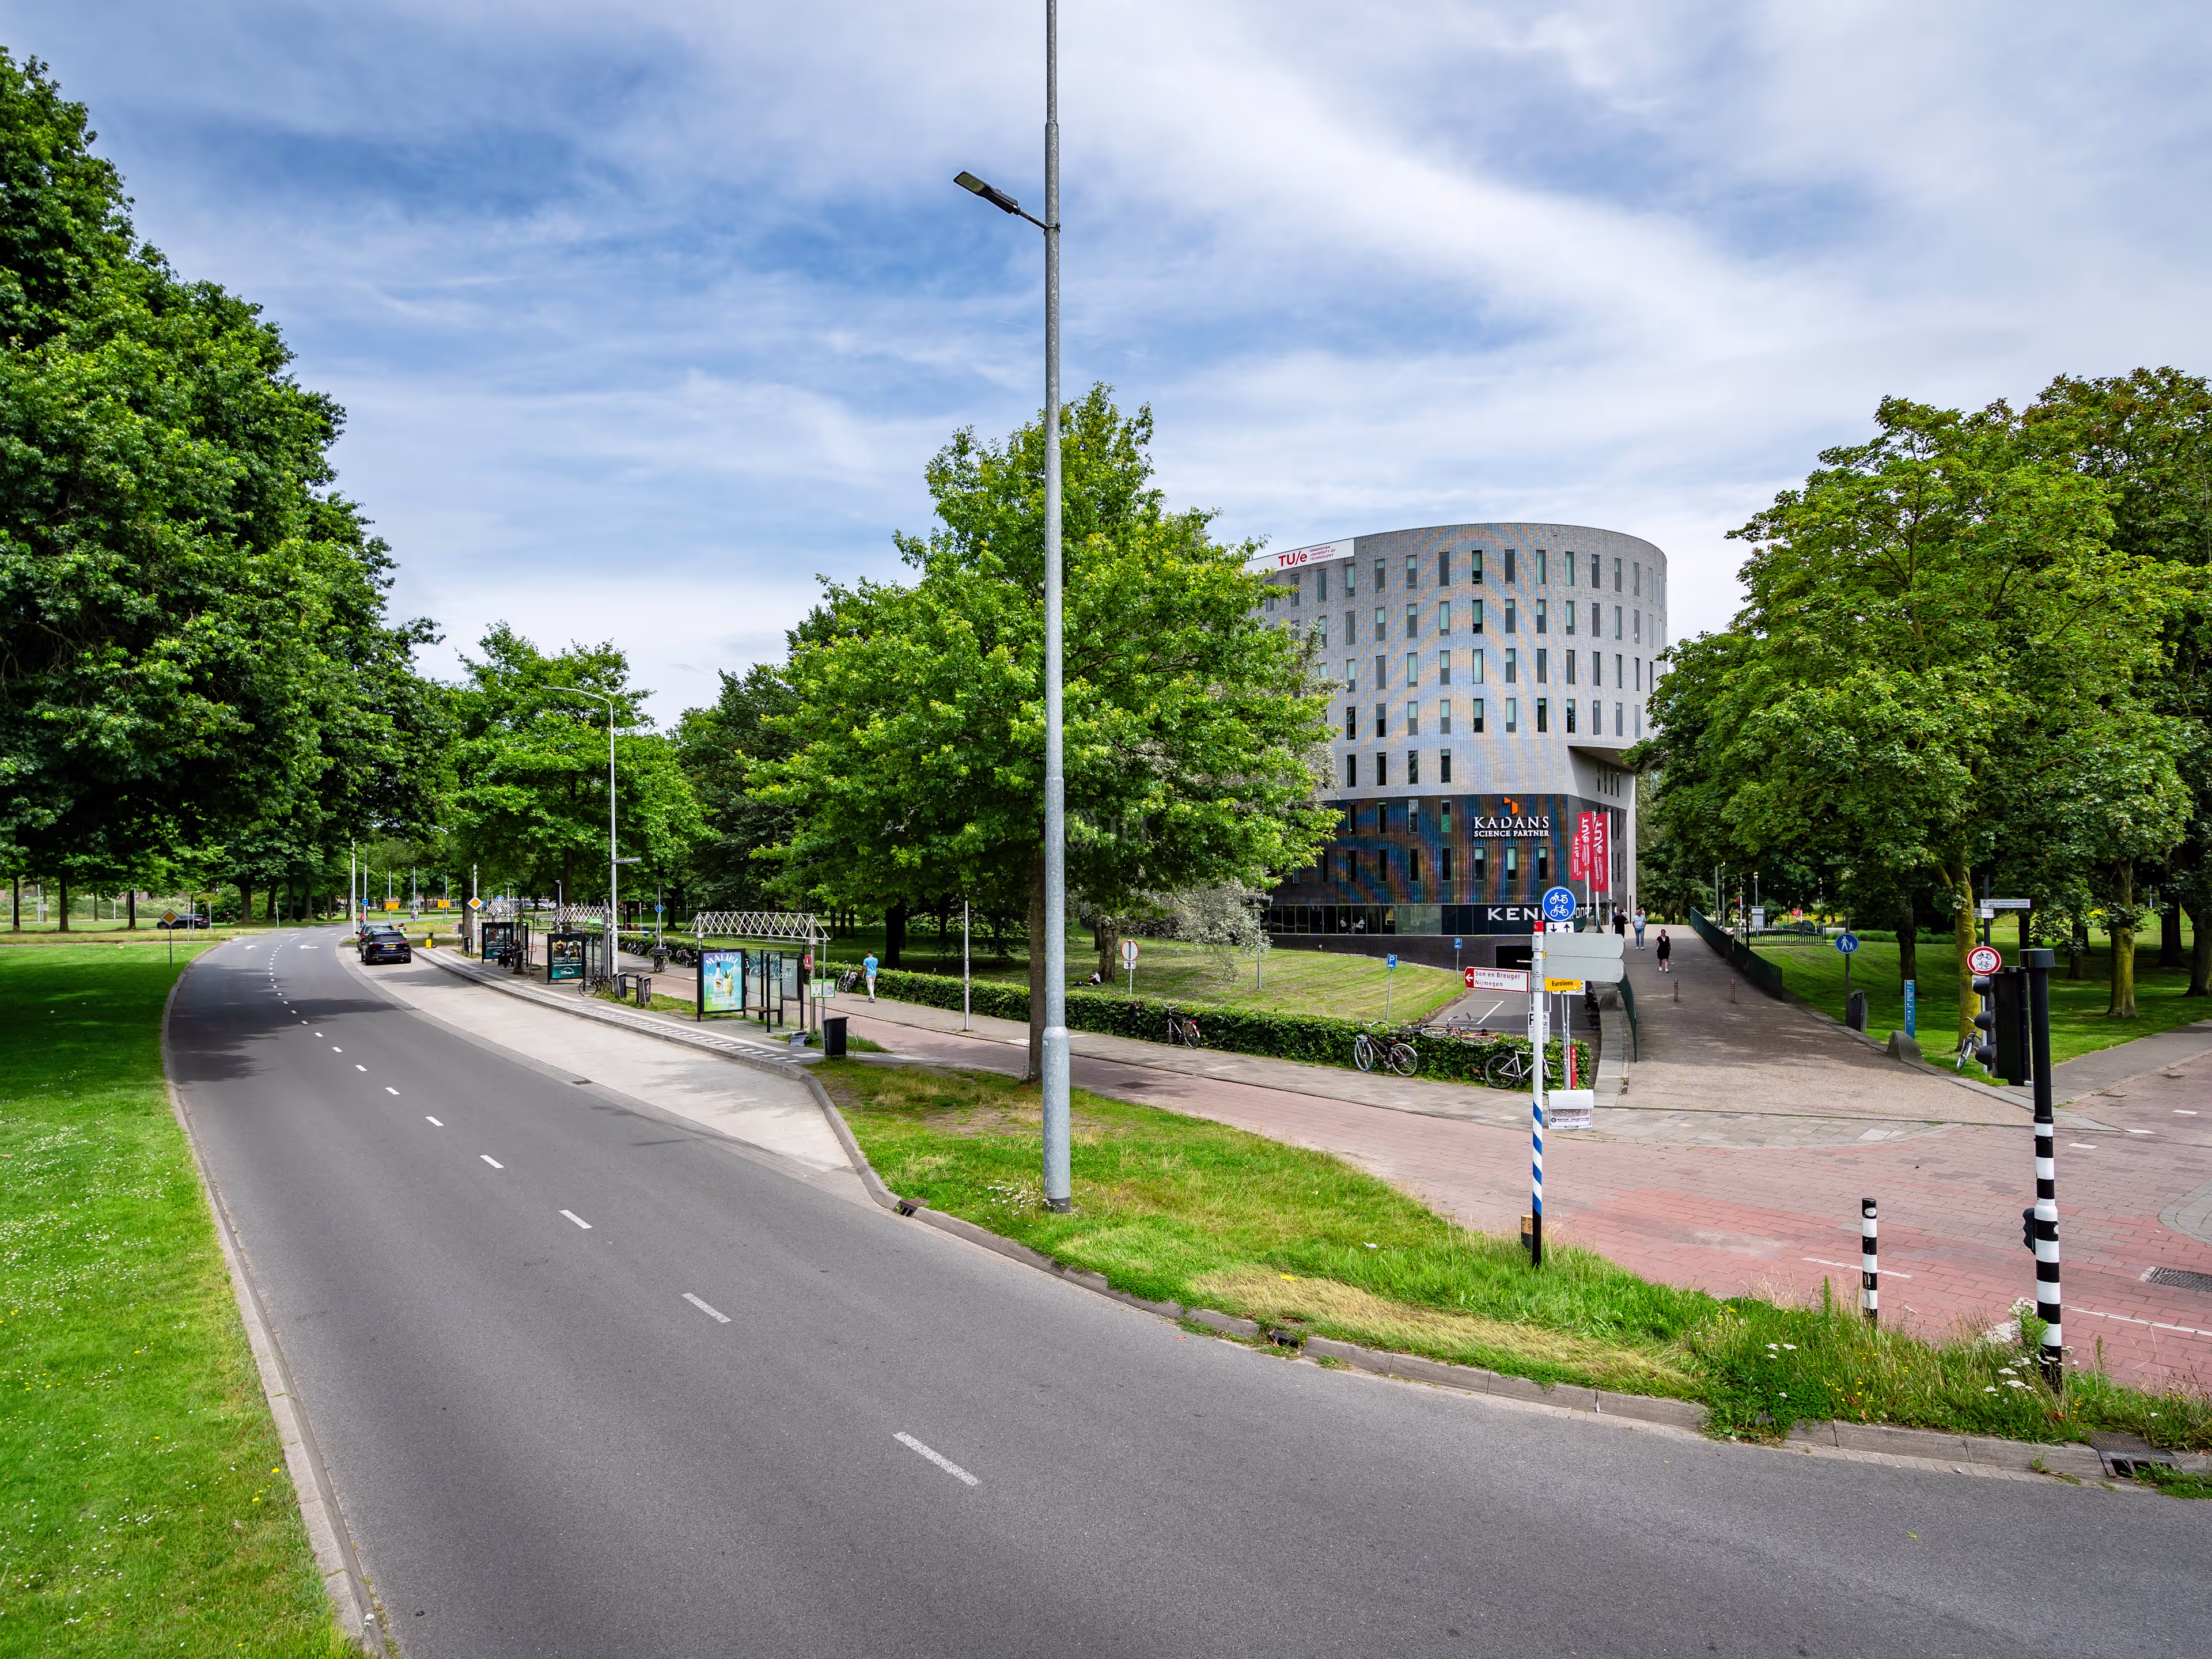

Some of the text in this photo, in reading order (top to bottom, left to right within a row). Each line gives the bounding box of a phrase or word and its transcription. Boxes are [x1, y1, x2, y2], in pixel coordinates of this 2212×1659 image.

[1278, 550, 1308, 567] TU/e
[1310, 553, 1334, 561] TECHNOLOGY
[1474, 816, 1550, 829] KADANS
[705, 953, 741, 968] MALIBU
[1497, 972, 1520, 980] Breugel
